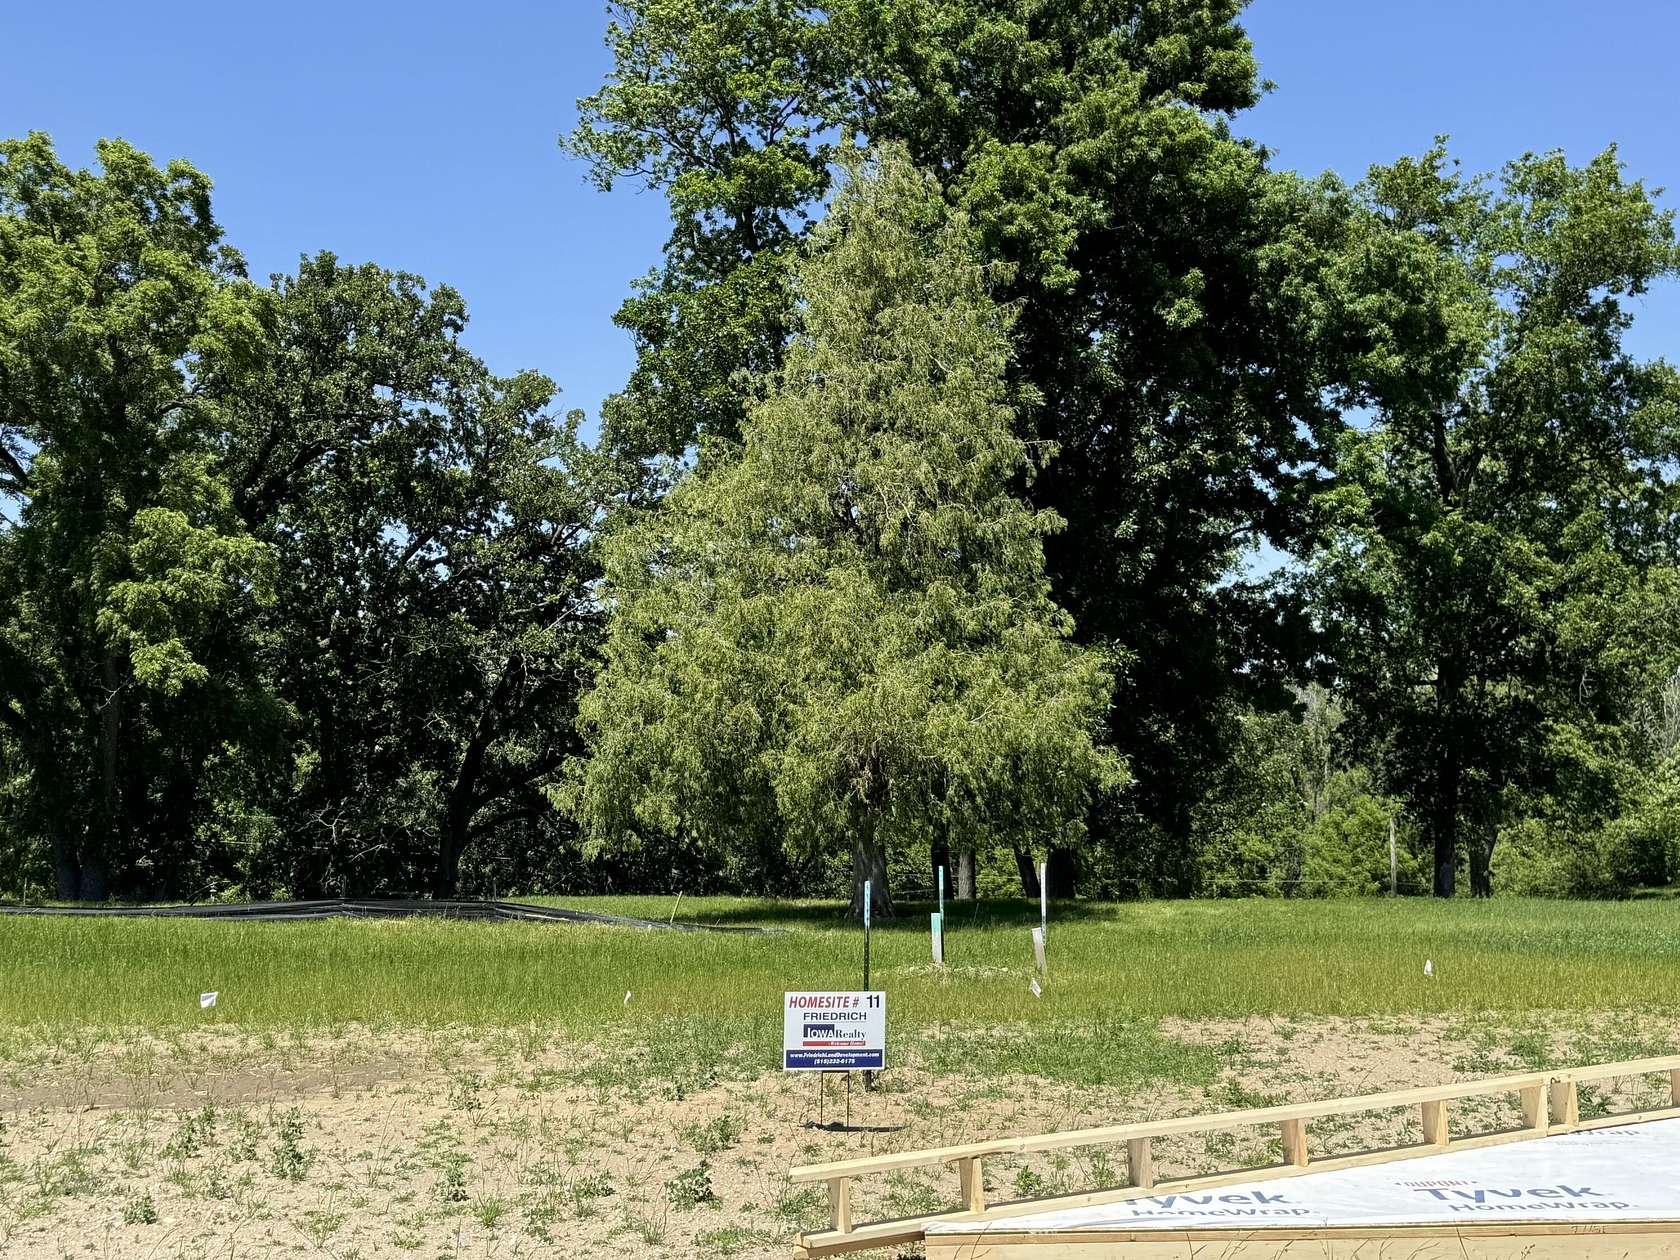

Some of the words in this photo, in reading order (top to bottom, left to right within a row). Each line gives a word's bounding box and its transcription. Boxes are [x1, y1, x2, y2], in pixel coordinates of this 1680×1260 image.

[789, 996, 850, 1008] HOMESITE
[852, 996, 860, 1008] #
[866, 994, 880, 1008] 11
[803, 1012, 867, 1021] FRIEDRICH
[1413, 1184, 1605, 1203] Tyvek
[1447, 1201, 1631, 1212] HomeWrap
